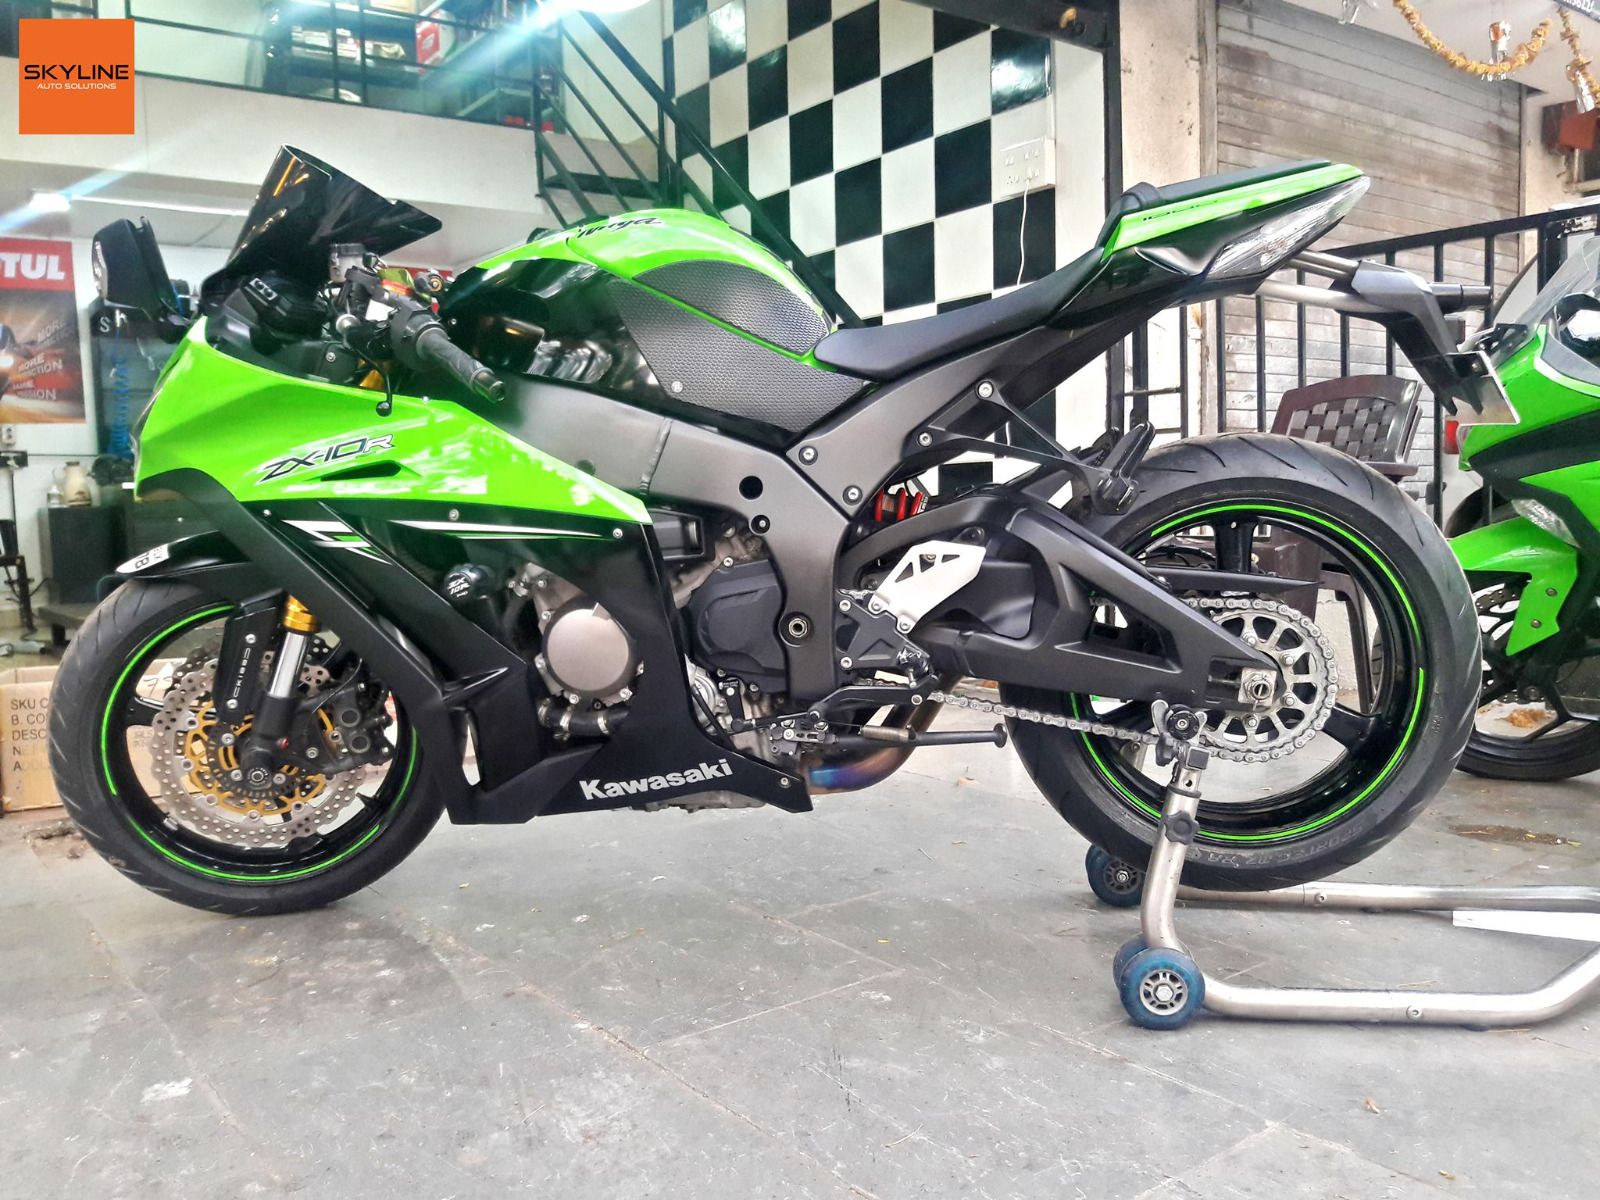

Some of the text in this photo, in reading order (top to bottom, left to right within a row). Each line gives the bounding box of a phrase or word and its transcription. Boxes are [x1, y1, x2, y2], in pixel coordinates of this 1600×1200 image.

[256, 433, 396, 484] ZX-10R
[11, 699, 36, 711] SKU
[579, 758, 734, 800] Kawasaki
